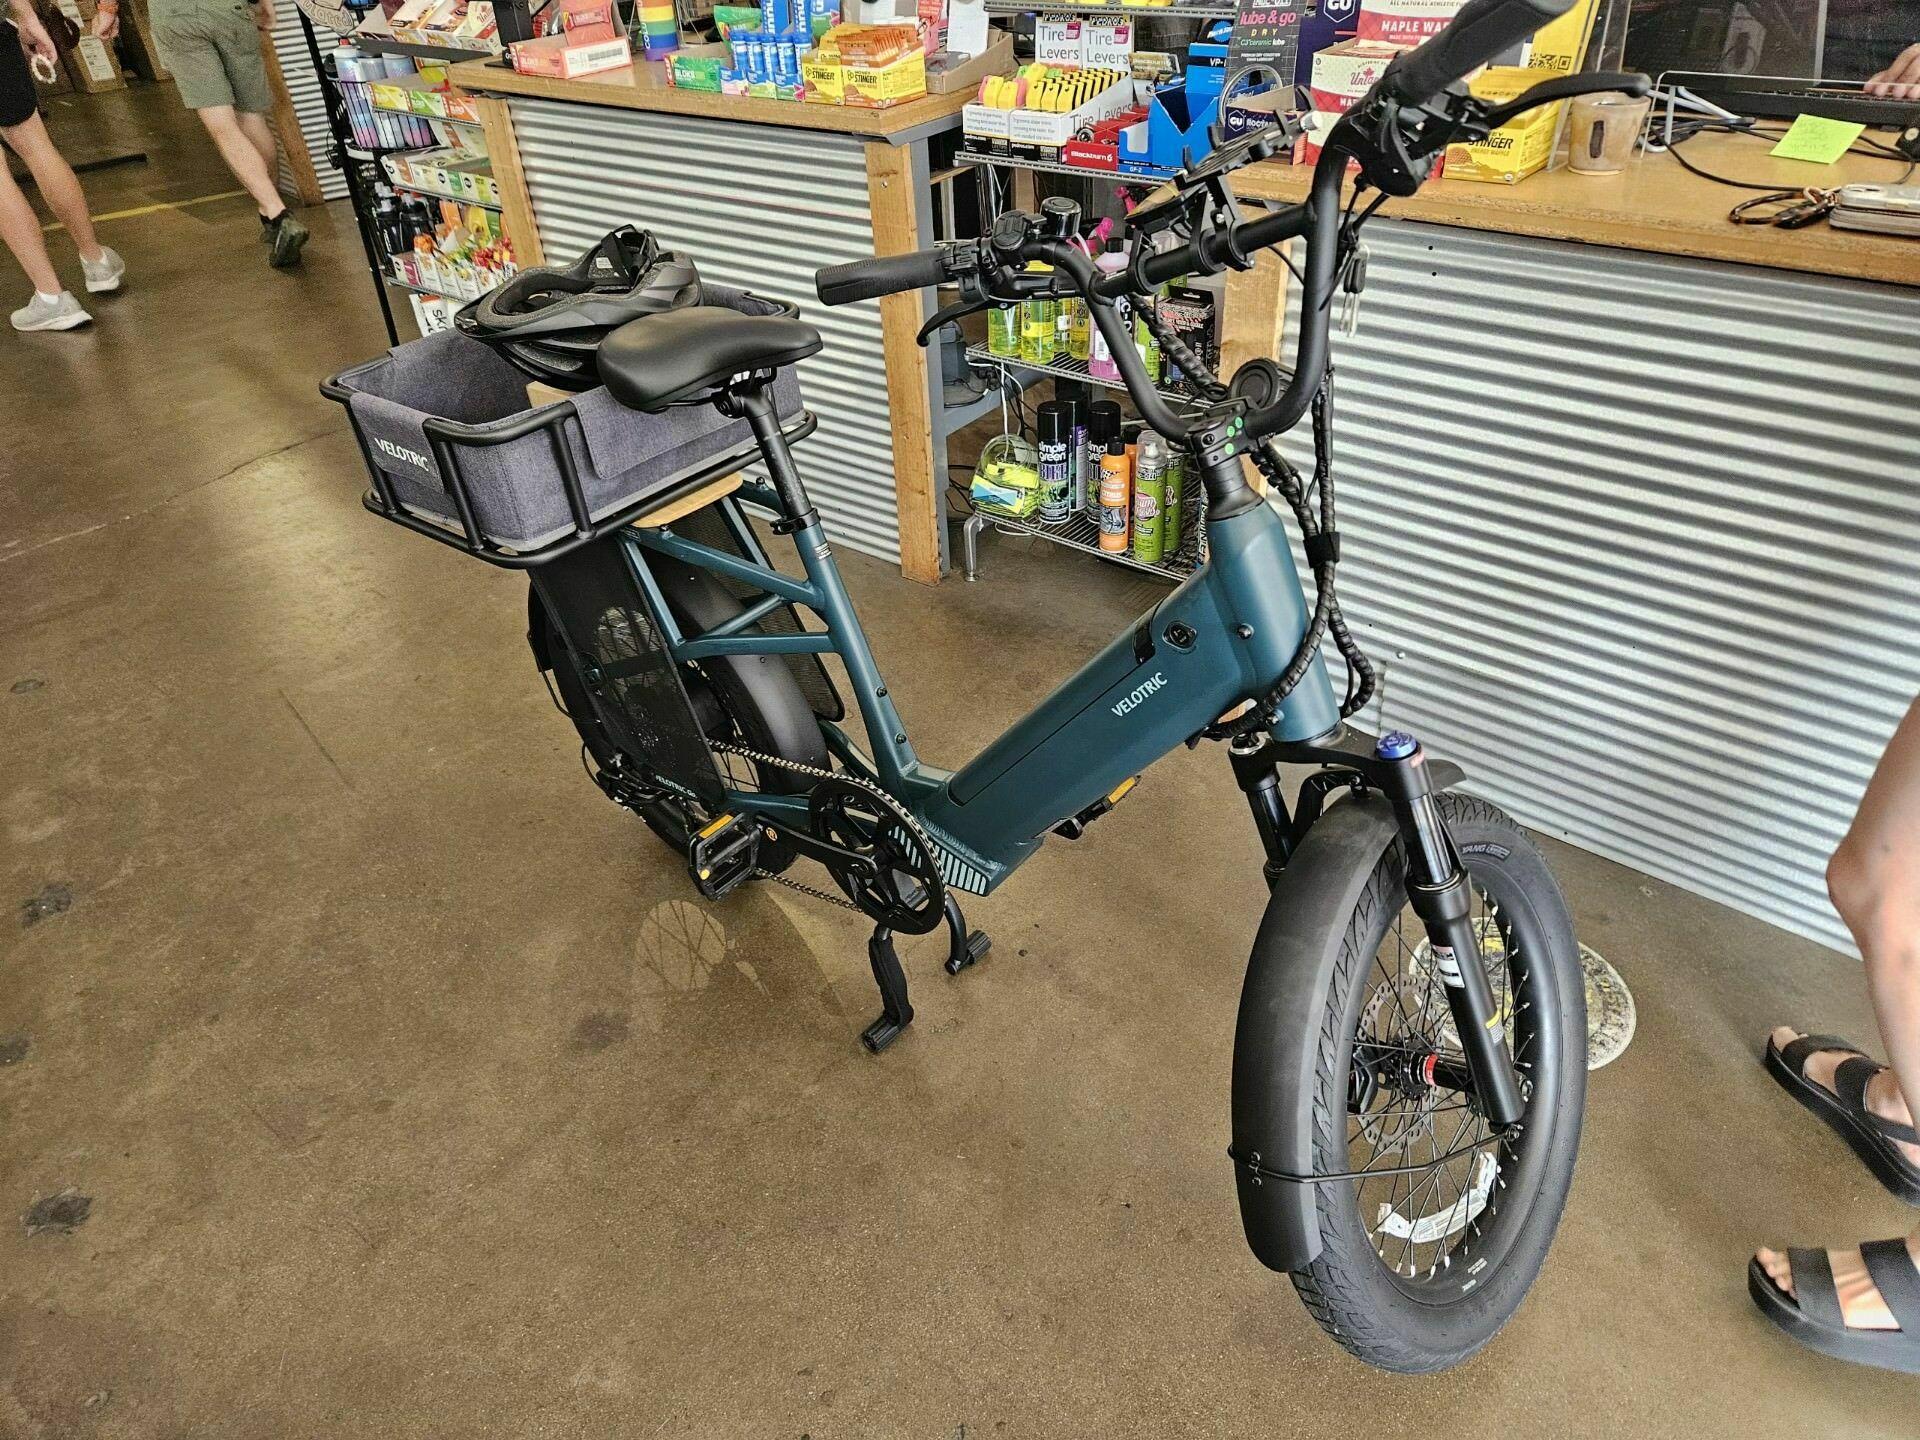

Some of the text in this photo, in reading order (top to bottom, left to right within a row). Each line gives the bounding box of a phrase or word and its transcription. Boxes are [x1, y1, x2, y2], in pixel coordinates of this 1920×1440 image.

[1240, 10, 1297, 26] lube & go
[1039, 25, 1065, 41] Tire
[1381, 20, 1419, 33] MAPLE
[1086, 29, 1113, 46] Tire
[1040, 44, 1079, 60] Levers
[1086, 47, 1129, 64] Levers
[812, 71, 835, 80] STINGER
[855, 75, 877, 84] STINGER
[1229, 117, 1243, 126] GU
[1071, 150, 1107, 161] Blackburn
[374, 437, 429, 472] VELOTRIC
[1111, 672, 1167, 717] VELOTRIC
